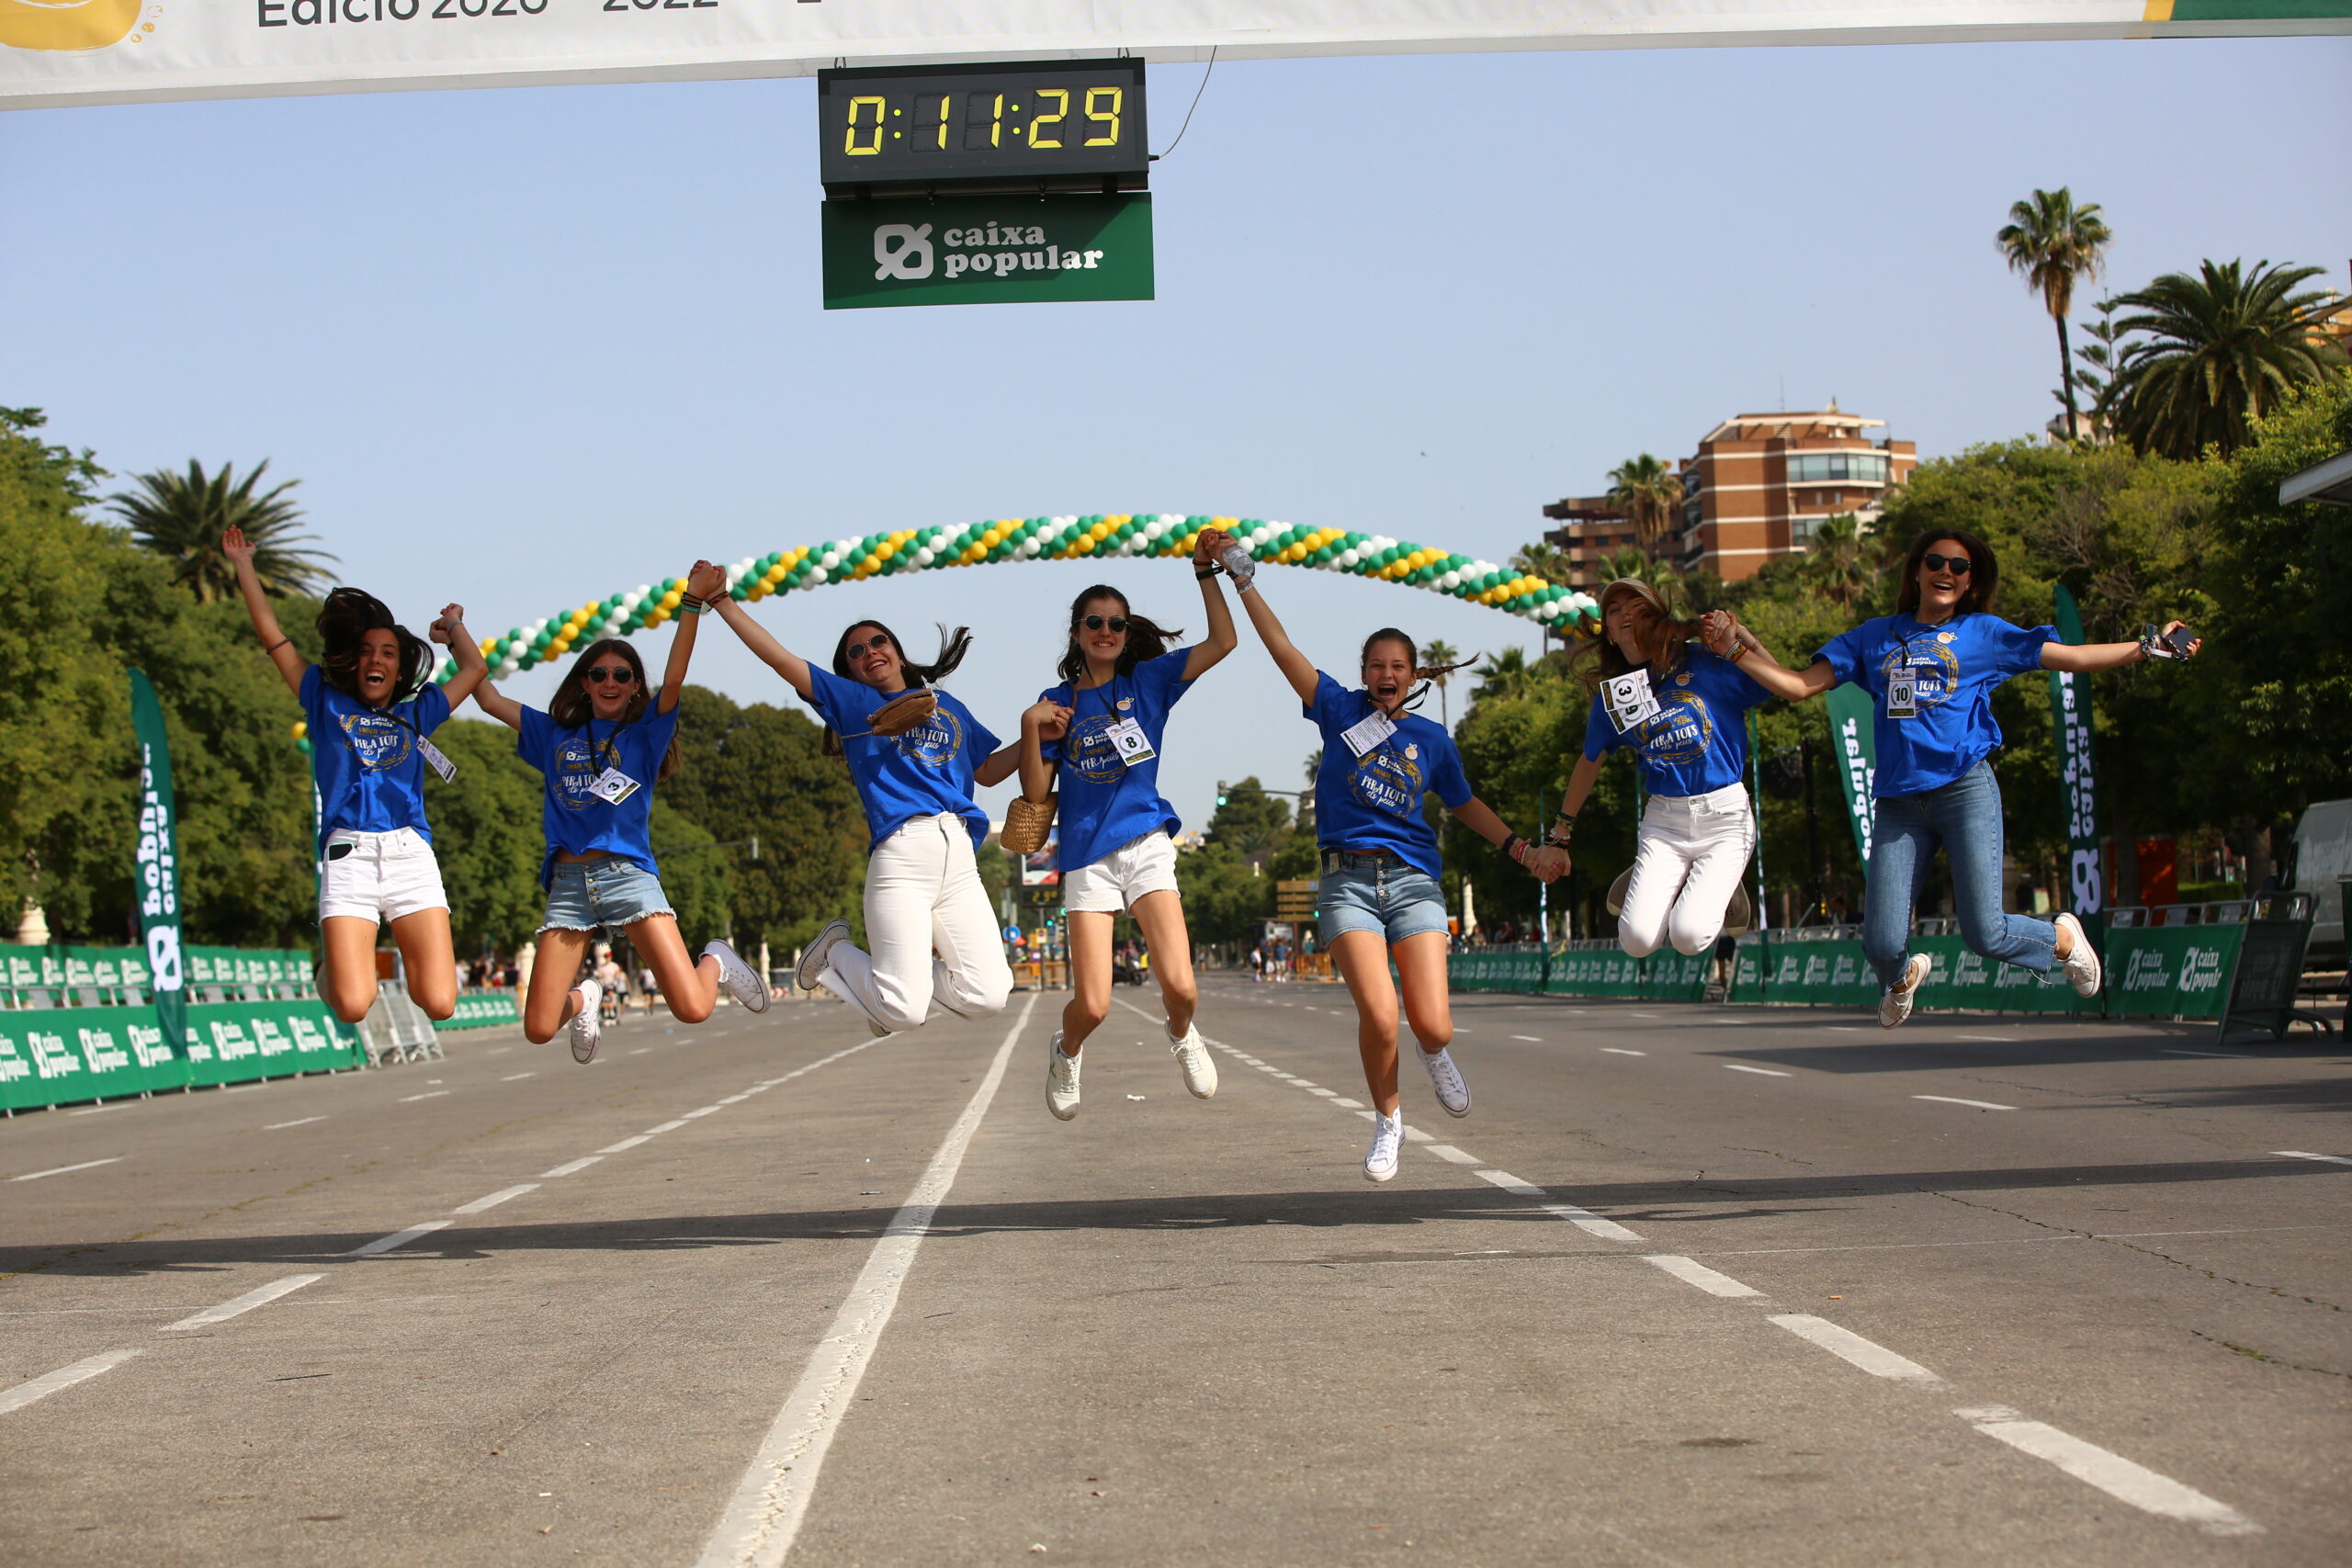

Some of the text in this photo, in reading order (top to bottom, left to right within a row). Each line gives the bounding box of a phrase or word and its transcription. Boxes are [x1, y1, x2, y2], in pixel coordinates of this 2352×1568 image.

[844, 86, 1123, 155] 0:11:29
[944, 220, 1046, 247] caixa
[944, 245, 1103, 278] popular
[1618, 685, 1633, 696] 3
[1894, 687, 1908, 702] 10
[379, 735, 399, 748] TOTS
[927, 729, 949, 745] TOTS
[1674, 724, 1699, 741] TOTS
[1125, 736, 1137, 749] 8
[607, 782, 620, 792] 3
[1384, 785, 1407, 805] TOTS
[2141, 948, 2164, 968] caixa
[2198, 946, 2220, 967] caixa
[2134, 967, 2171, 992] popular
